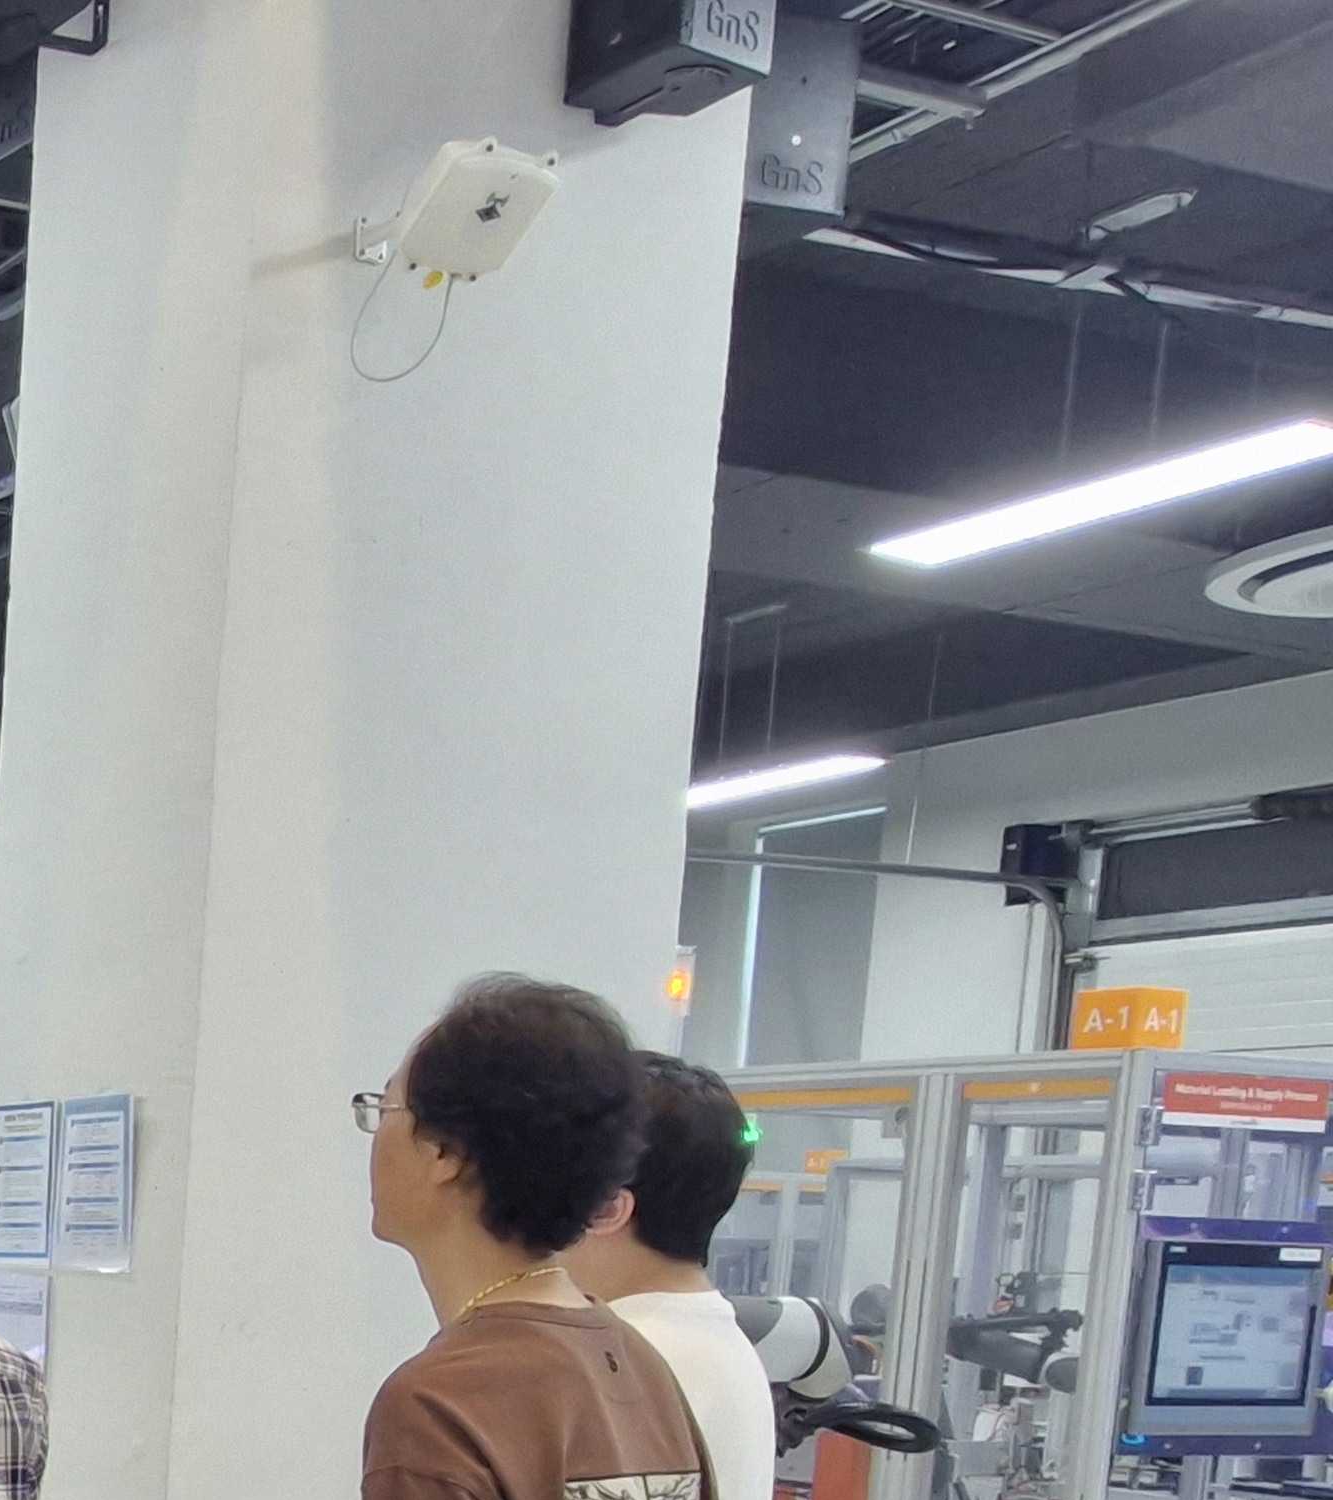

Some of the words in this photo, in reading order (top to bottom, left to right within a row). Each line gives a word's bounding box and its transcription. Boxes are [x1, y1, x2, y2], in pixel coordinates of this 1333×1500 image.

[706, 0, 760, 51] GnS
[761, 153, 824, 195] GnS
[1083, 1005, 1130, 1033] A-1
[1144, 1006, 1182, 1034] A-1
